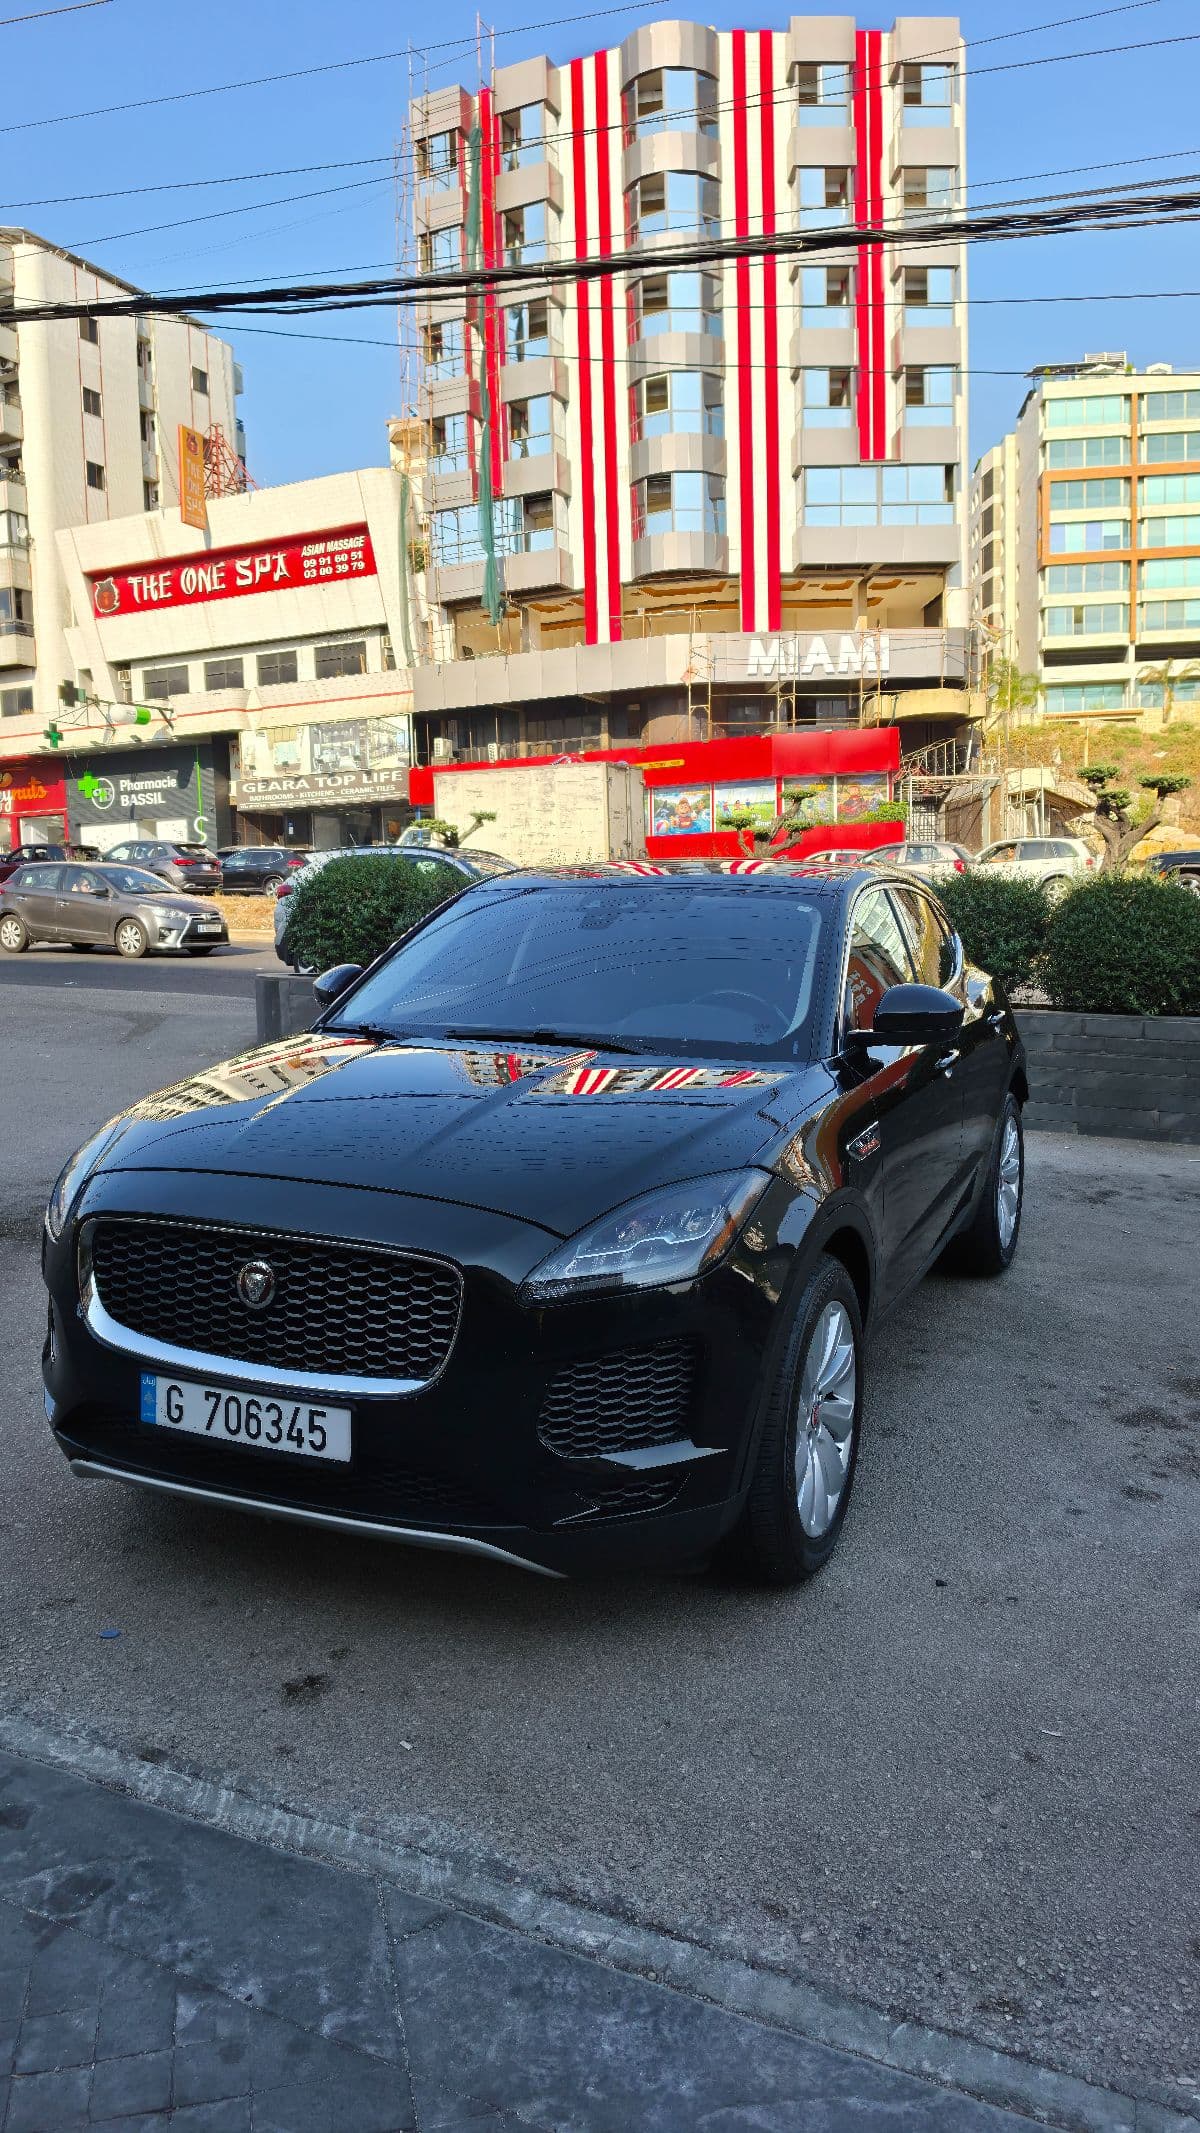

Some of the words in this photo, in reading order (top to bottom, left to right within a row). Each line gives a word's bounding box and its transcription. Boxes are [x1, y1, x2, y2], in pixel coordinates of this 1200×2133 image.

[301, 543, 325, 557] ASIAN
[327, 536, 366, 552] MASSAGE
[351, 550, 363, 560] 51
[127, 571, 173, 604] THE
[180, 561, 226, 595] ONE
[235, 551, 291, 587] SPA
[747, 634, 890, 676] MIAMI
[120, 776, 177, 792] Pharmacie
[242, 777, 310, 793] GEARA
[314, 775, 356, 788] TOP
[362, 770, 403, 783] LIFE
[0, 776, 48, 813] ynuts
[120, 791, 166, 807] BASSIL
[249, 793, 294, 802] BATHROOMS
[300, 789, 335, 799] KITCHENS
[341, 786, 374, 795] CERAMIC
[166, 1384, 184, 1424] G
[204, 1390, 327, 1451] 706345
